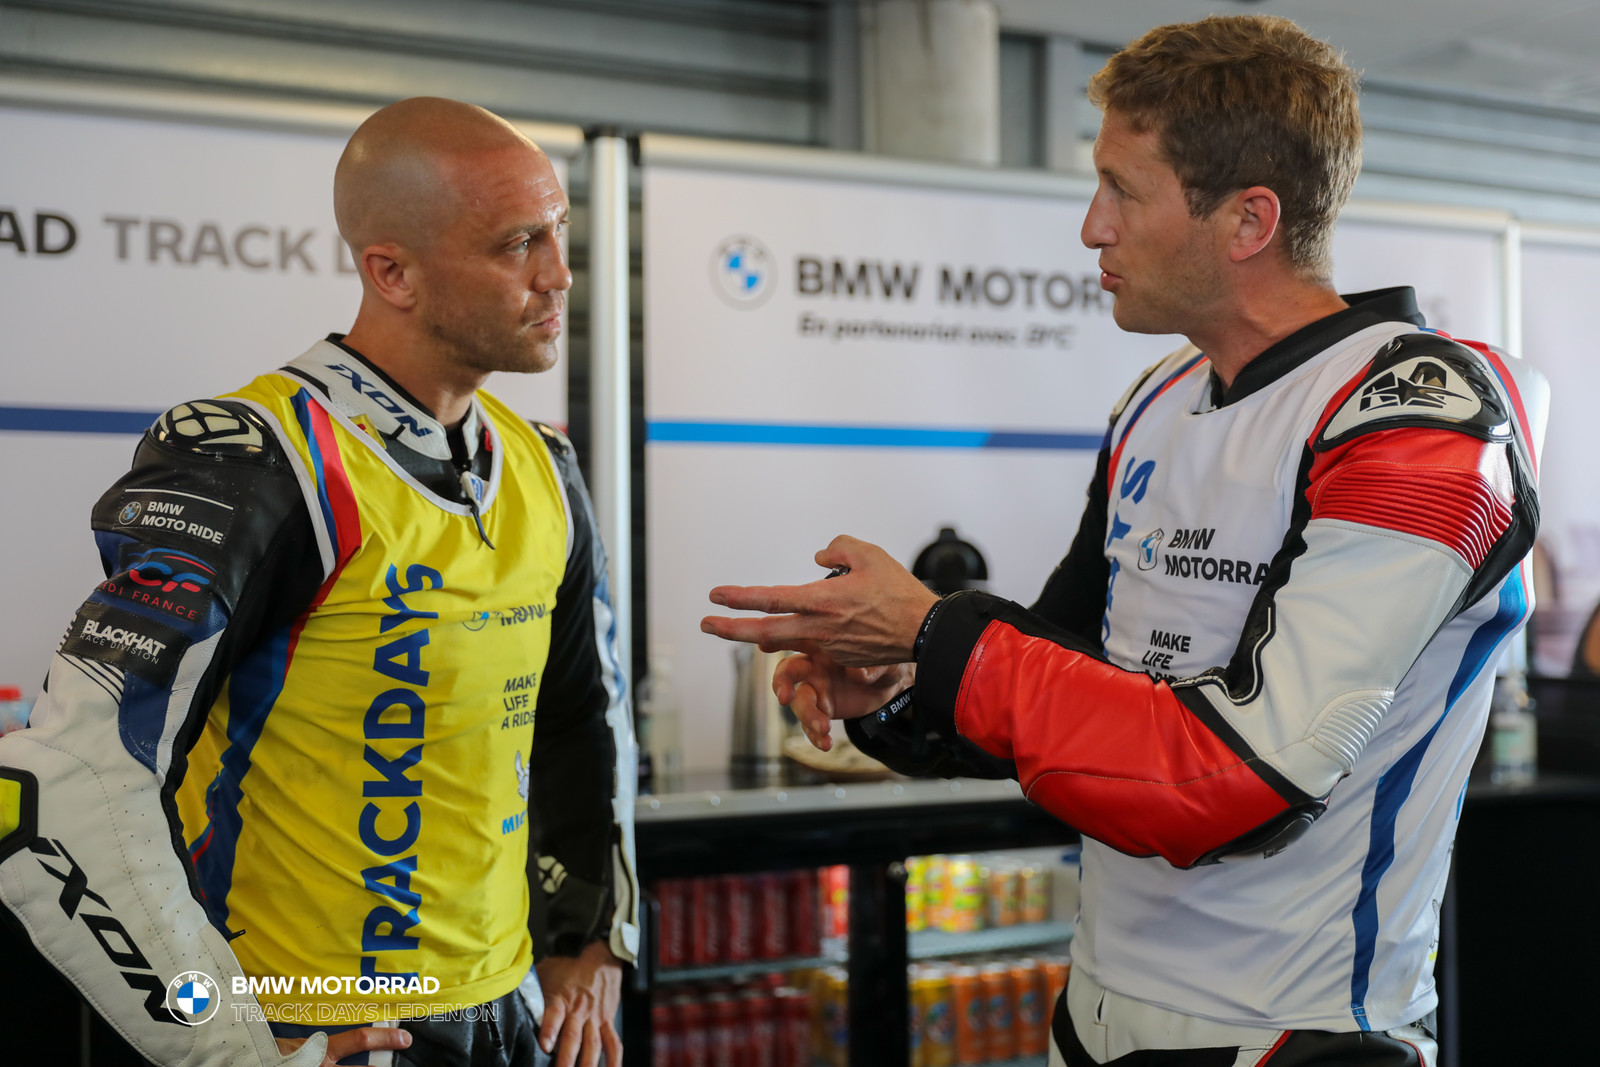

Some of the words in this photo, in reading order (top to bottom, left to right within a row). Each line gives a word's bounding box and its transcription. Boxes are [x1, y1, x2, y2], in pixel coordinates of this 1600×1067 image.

[103, 213, 320, 275] TRACK
[795, 256, 919, 299] BMW
[938, 266, 1113, 312] MOTOR
[147, 501, 184, 516] BMW
[141, 515, 186, 531] MOTO
[187, 523, 223, 544] RIDE
[1168, 528, 1215, 550] BMW
[1165, 554, 1271, 586] MOTORRA
[99, 581, 123, 595] IDI
[132, 591, 197, 619] FRANCE
[80, 632, 106, 646] RACE
[110, 642, 160, 664] DIVISION
[83, 619, 166, 656] BLACKHAT
[1150, 629, 1191, 653] MAKE
[1142, 650, 1174, 670] LIFE
[504, 672, 536, 693] MAKE
[503, 694, 529, 712] LIFE
[890, 692, 911, 714] BMW
[501, 716, 509, 730] A
